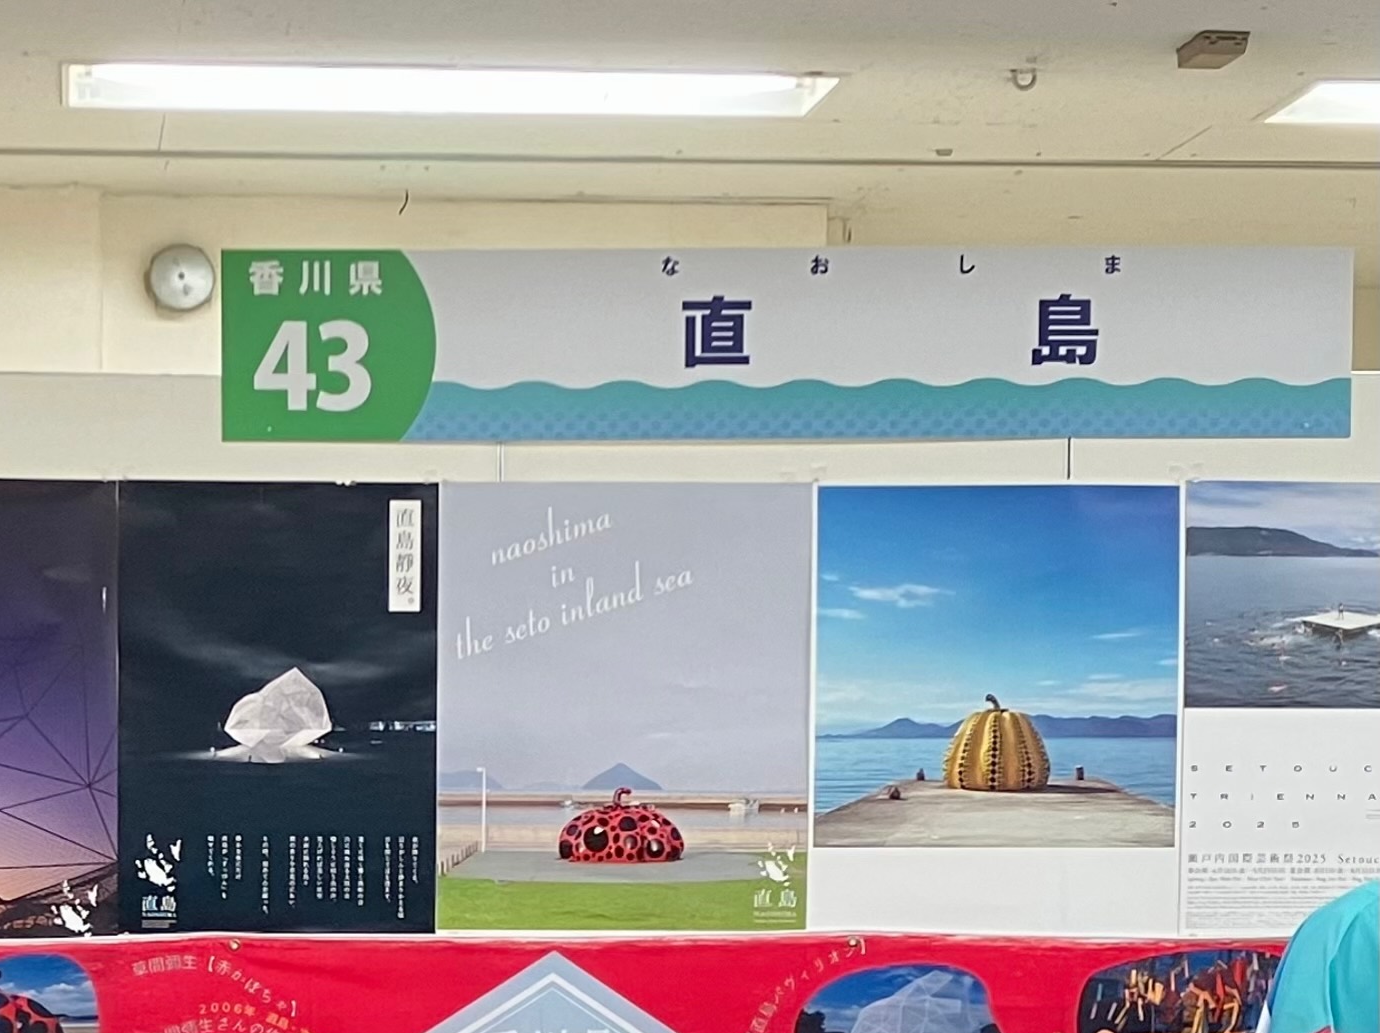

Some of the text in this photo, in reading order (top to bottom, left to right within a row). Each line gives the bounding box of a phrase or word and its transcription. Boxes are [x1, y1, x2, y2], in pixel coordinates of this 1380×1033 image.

[248, 259, 383, 297] 香川県
[661, 254, 1122, 277] なおしま
[681, 295, 1099, 368] 直島
[253, 318, 372, 413] 43
[395, 508, 415, 605] 直島静夜。
[491, 505, 612, 566] naoshima
[550, 564, 576, 589] in
[456, 560, 695, 660] the seto inland sea
[1189, 820, 1300, 829] 2025
